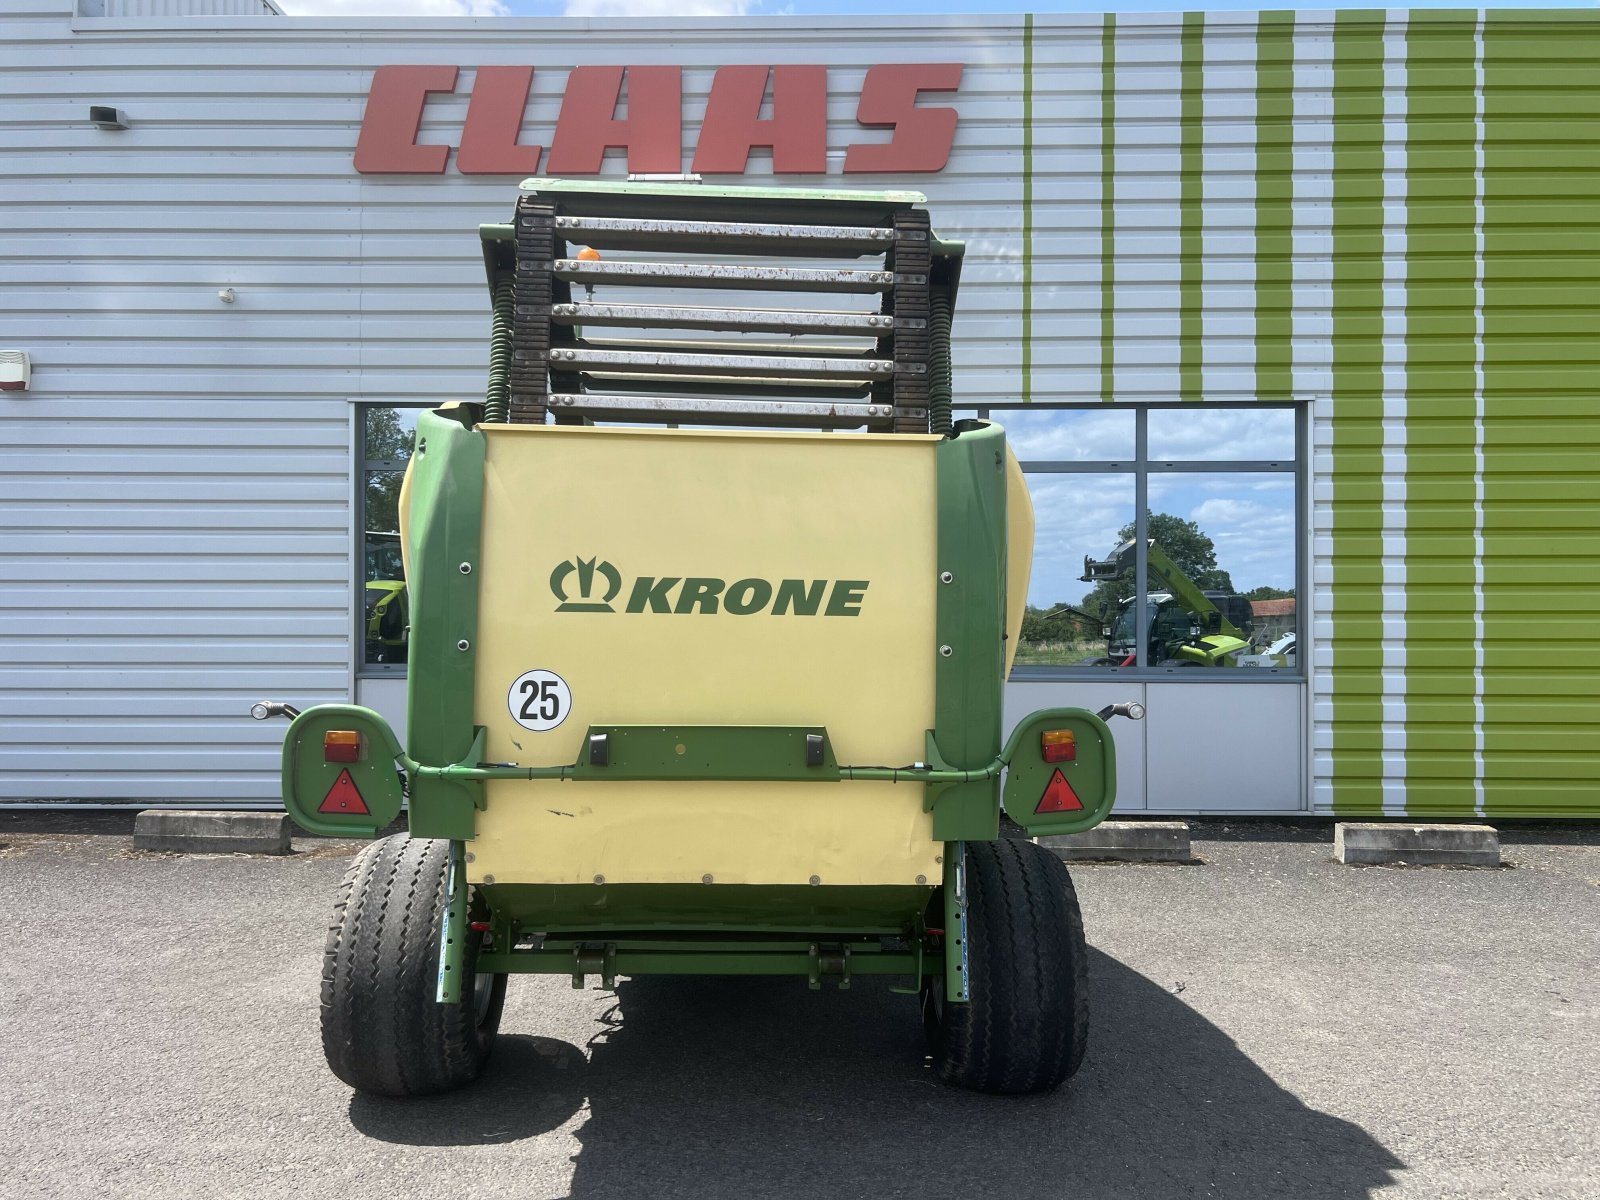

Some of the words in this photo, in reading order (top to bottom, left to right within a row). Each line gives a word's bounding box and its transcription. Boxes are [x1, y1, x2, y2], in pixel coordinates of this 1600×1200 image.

[354, 64, 964, 175] CLAAS
[624, 576, 870, 617] KRONE
[519, 680, 560, 721] 25
